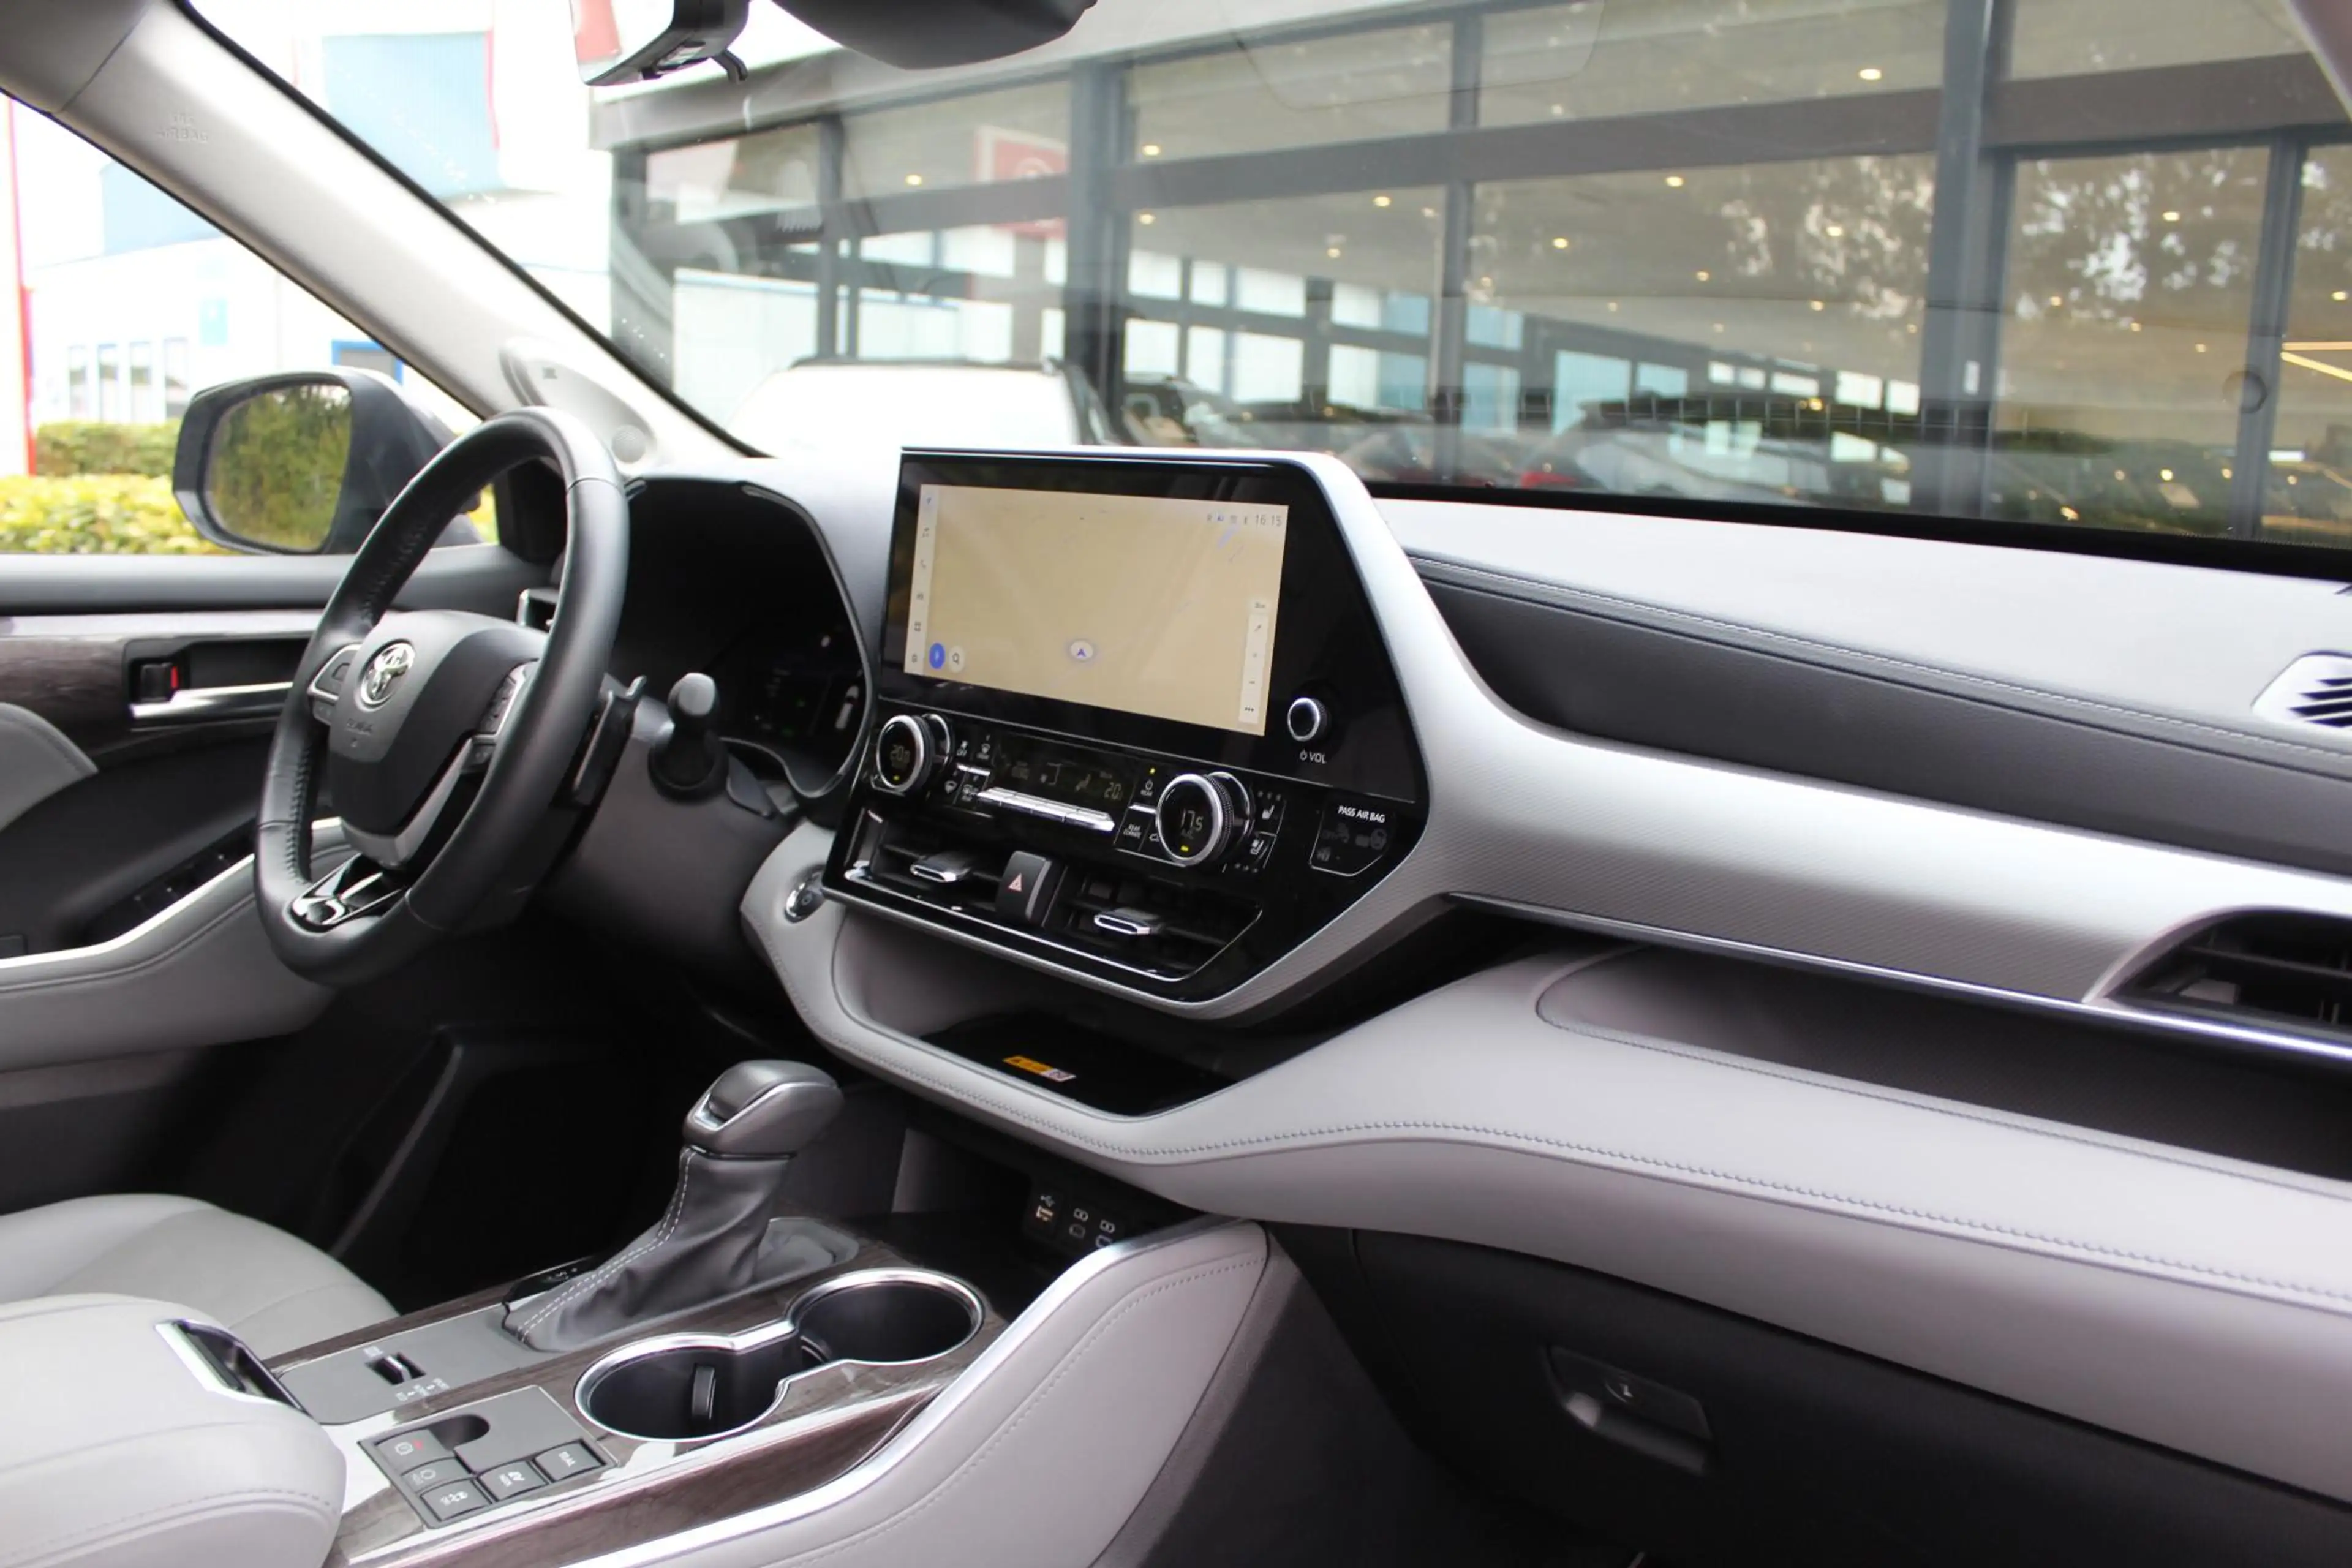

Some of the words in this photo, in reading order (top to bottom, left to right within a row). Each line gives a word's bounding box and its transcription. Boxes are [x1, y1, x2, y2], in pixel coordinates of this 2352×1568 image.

[1309, 752, 1327, 764] VOL
[1338, 805, 1355, 818] PASS
[1356, 810, 1369, 821] AIR
[1370, 812, 1385, 823] BAG
